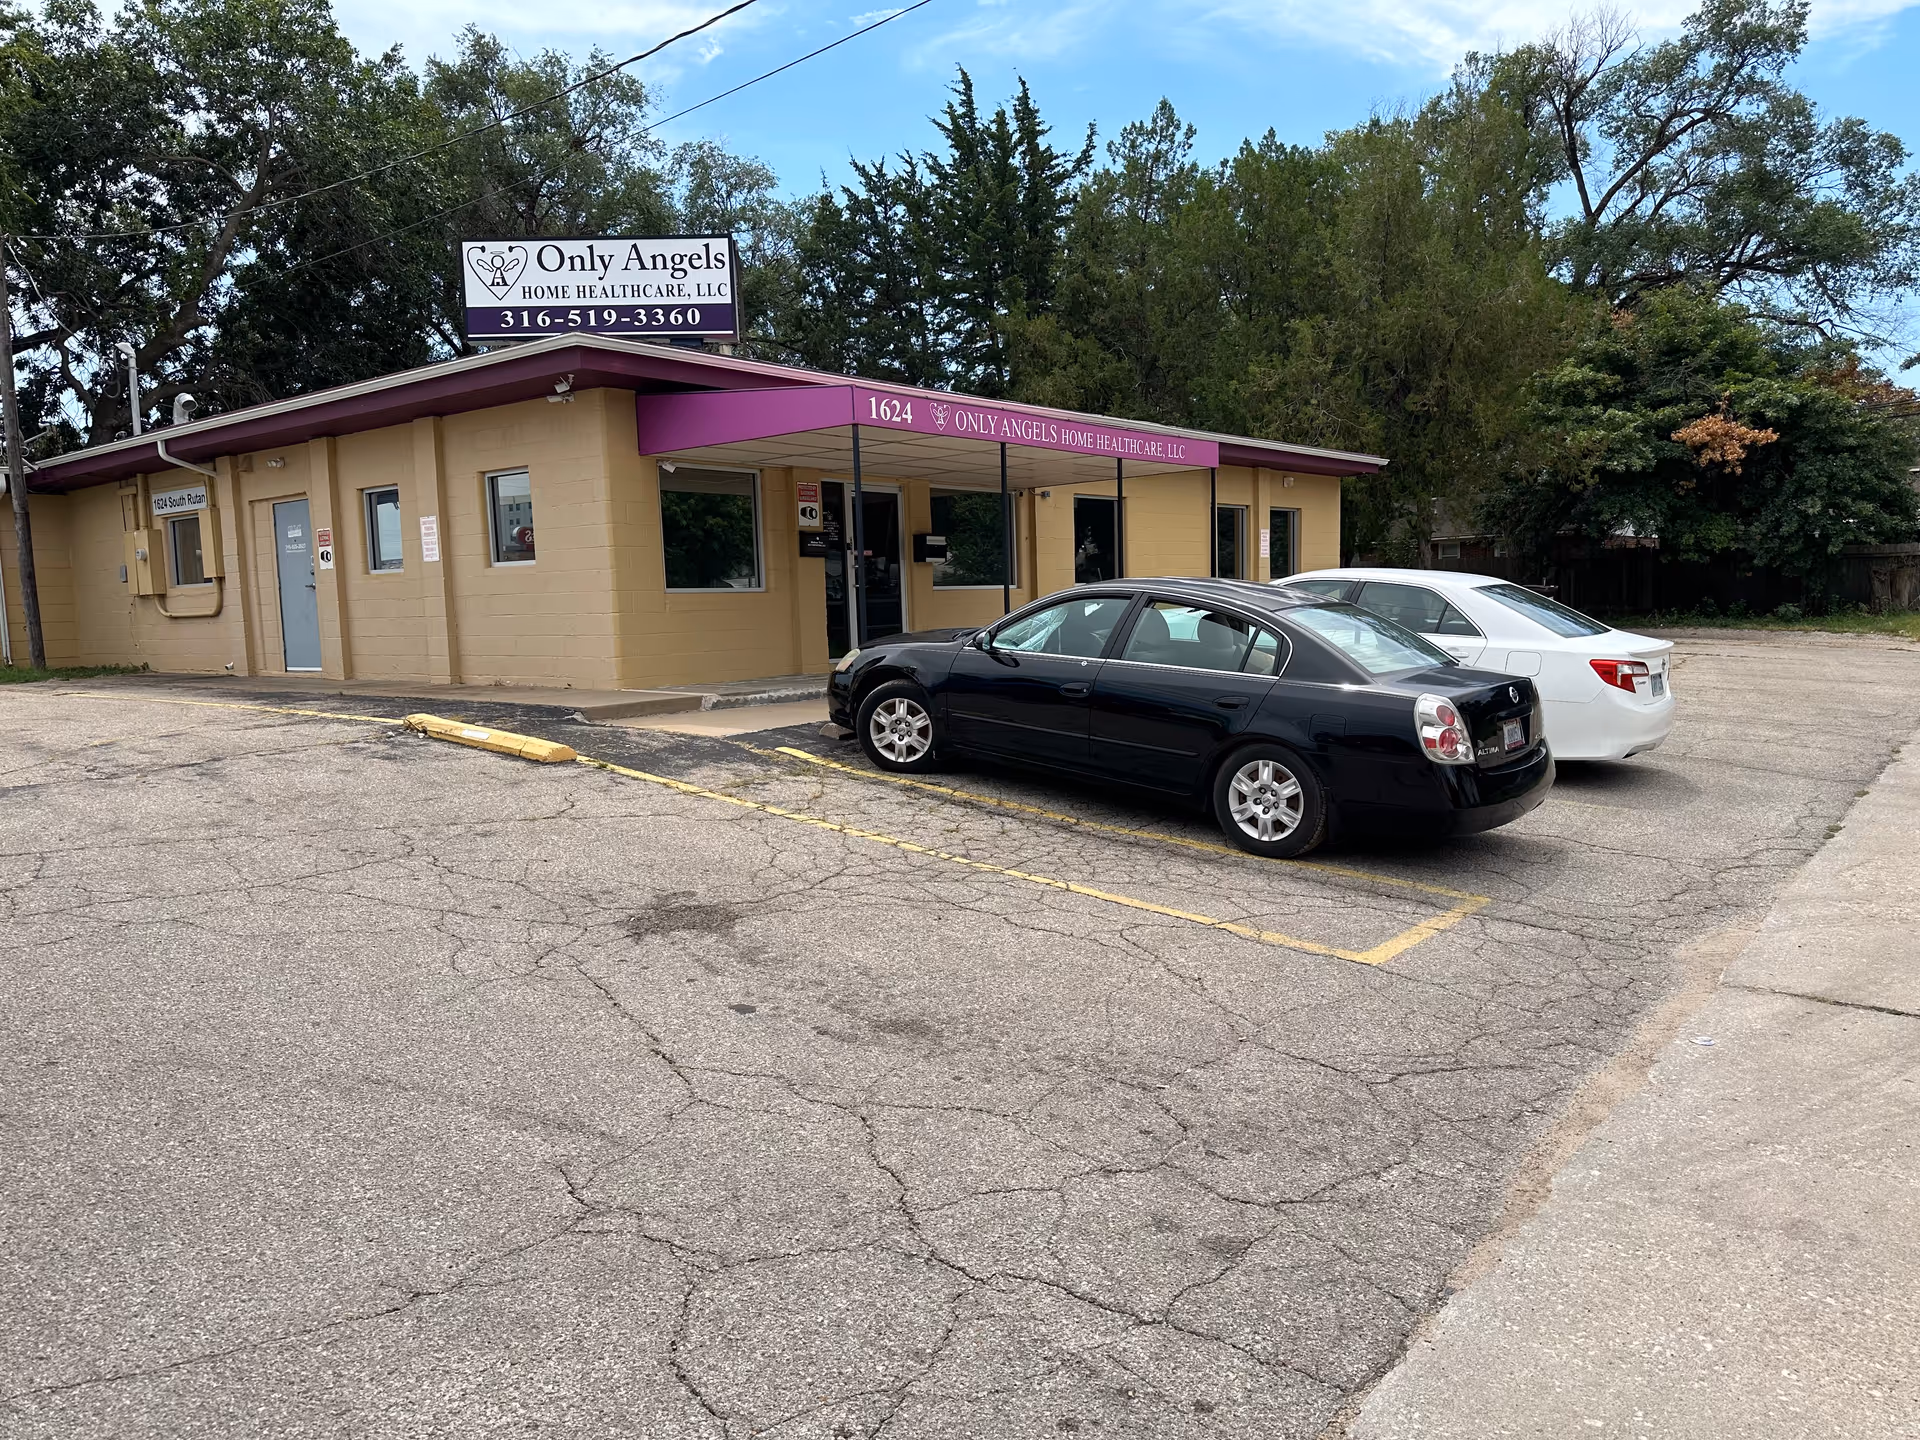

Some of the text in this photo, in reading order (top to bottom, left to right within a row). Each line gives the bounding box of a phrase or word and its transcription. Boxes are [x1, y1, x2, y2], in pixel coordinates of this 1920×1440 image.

[536, 242, 726, 281] Only Angels
[521, 282, 728, 300] HOME HEALTHCARE, LLC
[500, 307, 701, 328] 316-519-3360
[868, 396, 1186, 460] 1624 ONLY ANGELS HOME HEALTHCARE, LLC
[153, 493, 206, 510] 1624 South Rutan
[1477, 746, 1500, 757] ALTIMA
